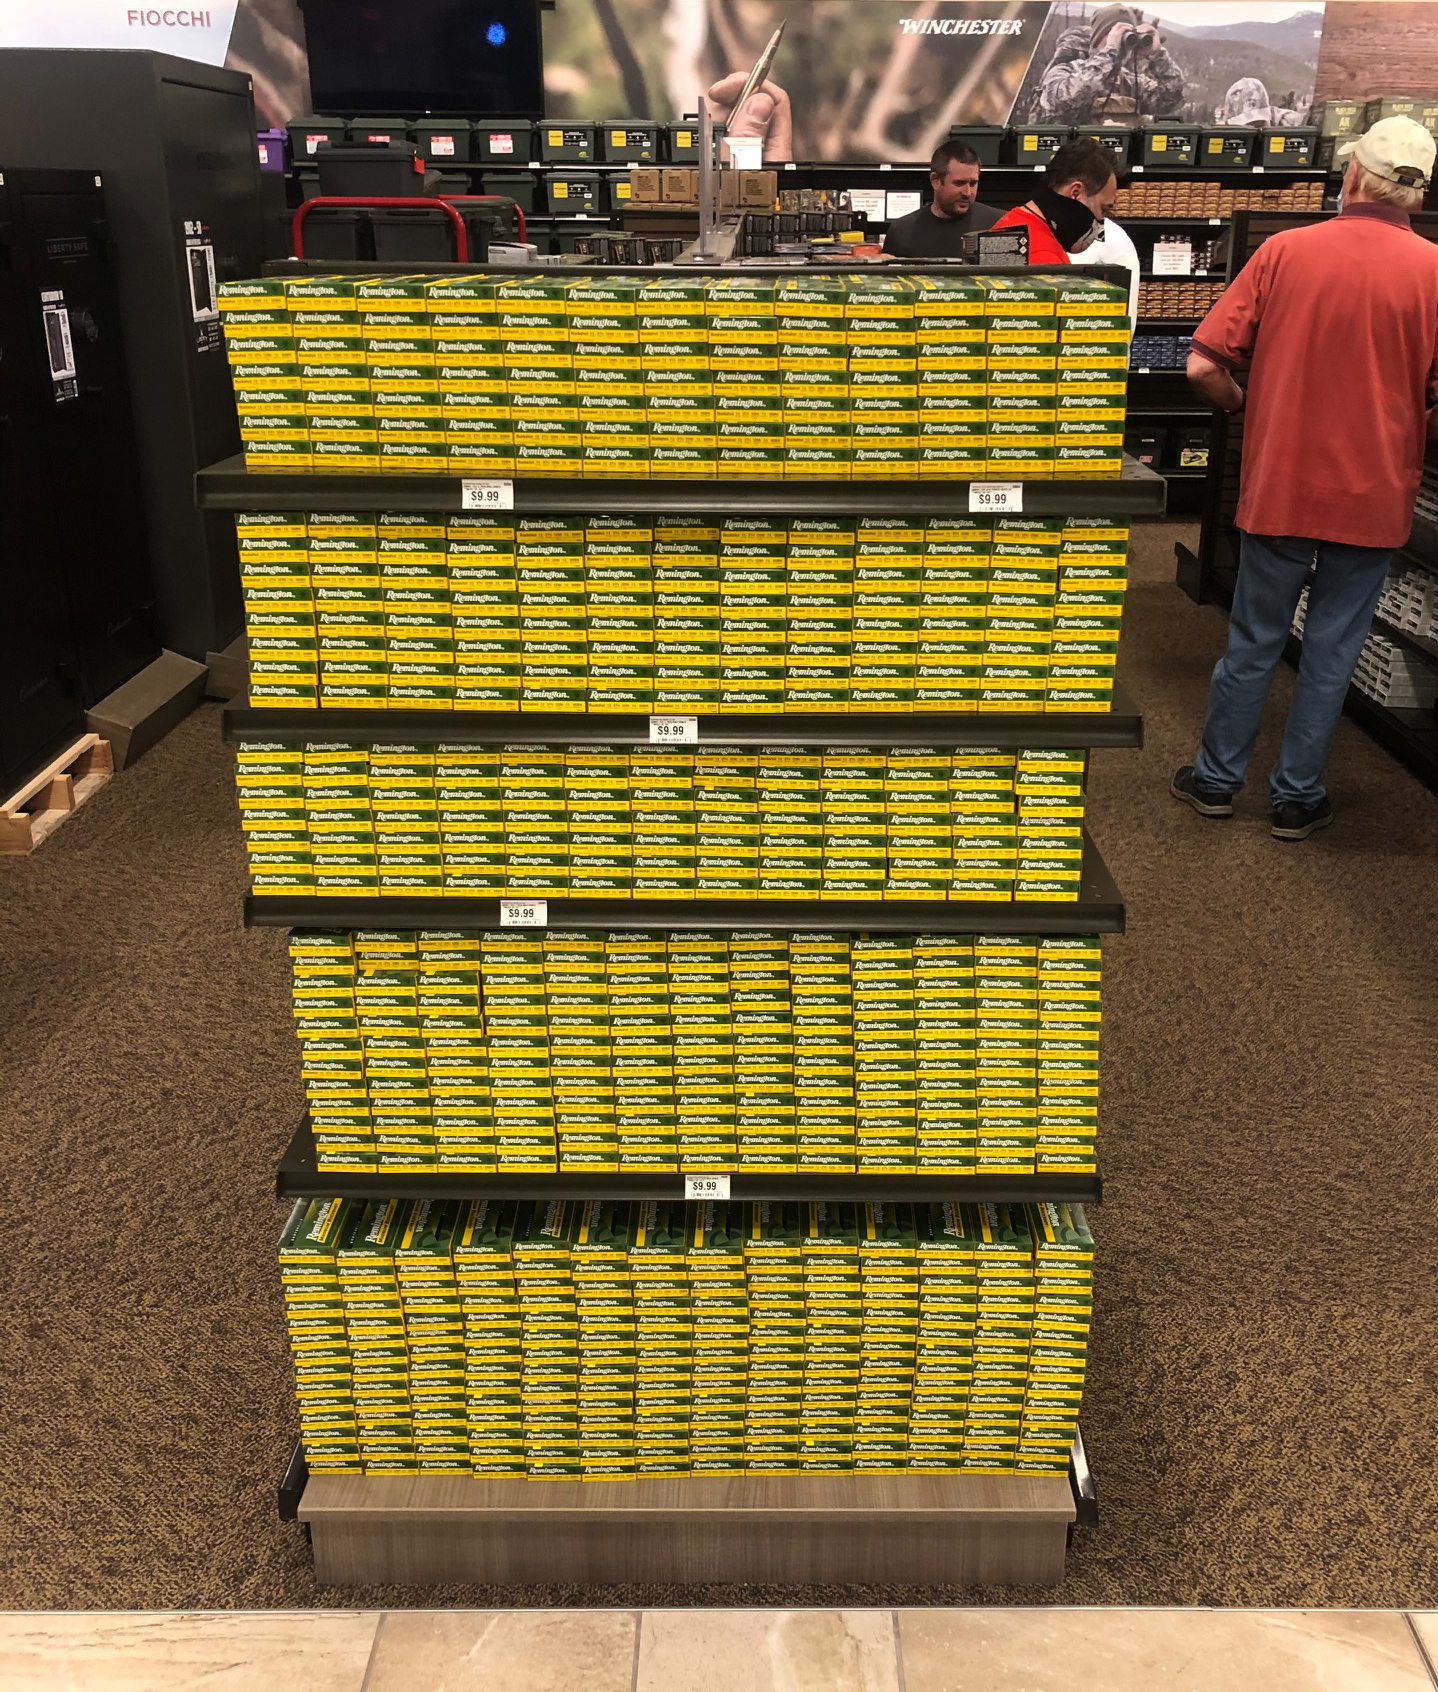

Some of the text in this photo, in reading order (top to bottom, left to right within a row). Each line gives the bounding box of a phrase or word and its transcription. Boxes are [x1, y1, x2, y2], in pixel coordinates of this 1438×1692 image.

[127, 10, 211, 27] FIOCCHI
[899, 18, 1026, 35] WINCHESTER
[219, 284, 267, 297] Remington
[289, 285, 337, 296] Remington
[359, 286, 407, 297] Remington
[429, 287, 477, 298] Remington
[499, 286, 547, 299] Remington
[568, 289, 617, 300] Remington
[639, 288, 687, 301] Remington
[708, 289, 757, 302] Remington
[778, 289, 828, 302] Remington
[918, 289, 968, 302] Remington
[988, 290, 1038, 301] Remington
[848, 293, 897, 304] Remington
[1060, 292, 1110, 302] Remington
[226, 313, 274, 323] Remington
[365, 314, 413, 324] Remington
[503, 315, 551, 326] Remington
[782, 318, 830, 329] Remington
[850, 319, 899, 330] Remington
[230, 339, 278, 350] Remington
[369, 341, 417, 351] Remington
[576, 344, 624, 354] Remington
[782, 345, 830, 356] Remington
[852, 347, 900, 357] Remington
[1061, 345, 1110, 355] Remington
[373, 367, 420, 378] Remington
[511, 369, 558, 379] Remington
[647, 371, 695, 382] Remington
[717, 372, 764, 382] Remington
[853, 373, 901, 383] Remington
[307, 392, 355, 402] Remington
[514, 395, 561, 405] Remington
[650, 397, 697, 407] Remington
[787, 399, 834, 409] Remington
[923, 398, 971, 408] Remington
[312, 417, 359, 428] Remington
[449, 420, 496, 430] Remington
[653, 423, 700, 433] Remington
[924, 424, 971, 434] Remington
[1060, 423, 1107, 433] Remington
[248, 442, 295, 452] Remington
[451, 446, 498, 456] Remington
[585, 448, 632, 458] Remington
[789, 449, 835, 460] Remington
[991, 449, 1038, 458] Remington
[471, 490, 499, 502] $9.99
[978, 493, 1007, 505] $9.99
[311, 514, 358, 523] Remington
[380, 515, 427, 524] Remington
[861, 519, 908, 528] Remington
[520, 521, 566, 530] Remington
[310, 540, 358, 550] Remington
[519, 545, 566, 555] Remington
[588, 544, 634, 554] Remington
[655, 543, 701, 553] Remington
[790, 547, 837, 557] Remington
[383, 566, 431, 575] Remington
[589, 569, 635, 579] Remington
[858, 569, 905, 579] Remington
[993, 570, 1040, 581] Remington
[318, 589, 365, 599] Remington
[454, 593, 501, 603] Remington
[590, 594, 636, 603] Remington
[857, 594, 904, 604] Remington
[723, 596, 769, 605] Remington
[320, 614, 368, 623] Remington
[591, 618, 637, 628] Remington
[657, 619, 703, 628] Remington
[723, 621, 769, 630] Remington
[922, 619, 969, 629] Remington
[390, 640, 436, 650] Remington
[593, 643, 638, 652] Remington
[921, 643, 967, 652] Remington
[1054, 643, 1101, 652] Remington
[253, 662, 300, 672] Remington
[458, 665, 505, 675] Remington
[853, 667, 899, 676] Remington
[658, 668, 703, 677] Remington
[985, 668, 1031, 677] Remington
[323, 686, 370, 696] Remington
[523, 690, 569, 699] Remington
[788, 691, 833, 700] Remington
[1049, 691, 1095, 700] Remington
[657, 725, 684, 736] $9.99
[1022, 750, 1068, 759] Remington
[371, 767, 416, 776] Remington
[567, 768, 611, 777] Remington
[953, 769, 998, 778] Remington
[307, 789, 352, 798] Remington
[505, 790, 549, 799] Remington
[761, 791, 805, 800] Remington
[890, 792, 935, 801] Remington
[377, 812, 422, 821] Remington
[572, 813, 616, 821] Remington
[827, 815, 871, 823] Remington
[249, 832, 295, 840] Remington
[445, 834, 489, 842] Remington
[700, 836, 743, 845] Remington
[892, 837, 936, 846] Remington
[315, 855, 360, 864] Remington
[509, 856, 553, 865] Remington
[894, 859, 938, 867] Remington
[957, 858, 1001, 867] Remington
[382, 877, 426, 885] Remington
[572, 879, 615, 887] Remington
[887, 880, 931, 889] Remington
[508, 908, 534, 918] $9.99
[692, 1181, 717, 1191] $9.99
[306, 1202, 332, 1241] Remington
